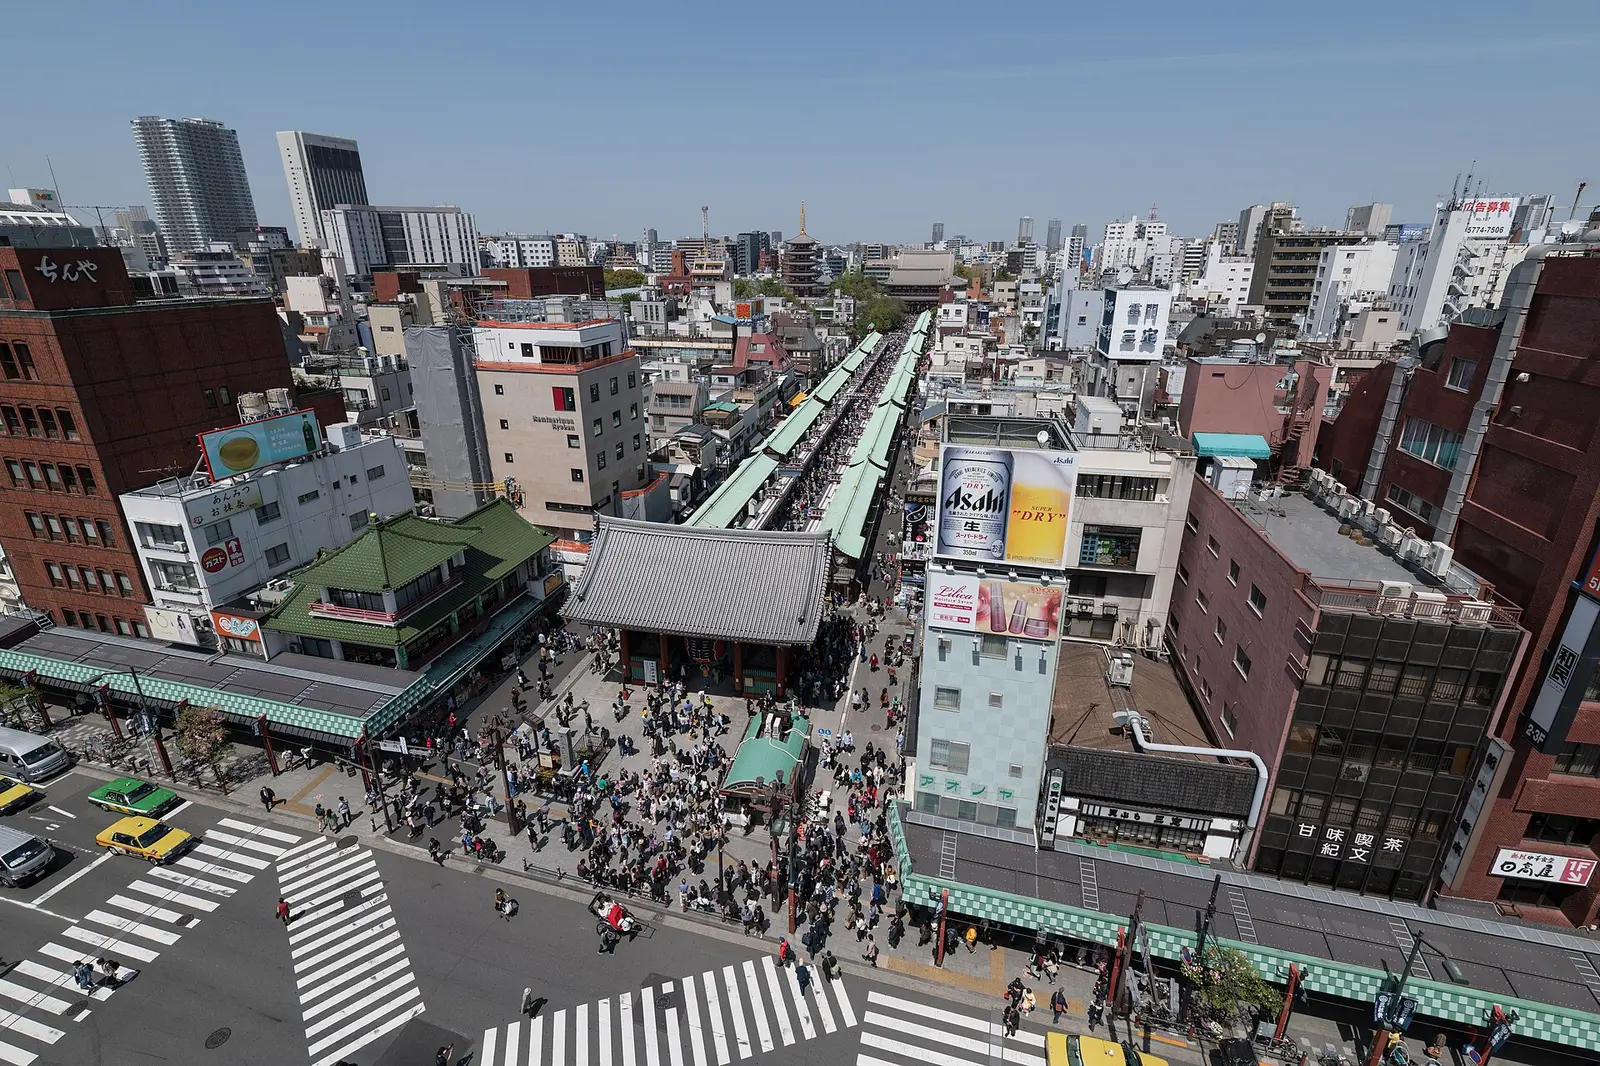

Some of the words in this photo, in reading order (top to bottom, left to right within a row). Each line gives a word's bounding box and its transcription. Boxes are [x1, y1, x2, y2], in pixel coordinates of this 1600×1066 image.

[1464, 201, 1511, 213] 広告募集
[34, 255, 98, 283] ちんや
[1127, 303, 1159, 323] 雷門
[1053, 456, 1073, 465] Asahi
[213, 486, 250, 505] あんみつ
[945, 485, 1005, 514] Asahi
[211, 499, 245, 517] お抹茶
[964, 521, 980, 532] 生
[956, 533, 988, 541] スーパードライ
[205, 555, 226, 568] ガスト
[1552, 648, 1577, 687] 和民
[921, 775, 1012, 801] アオノヤ
[1299, 823, 1404, 852] 甘味喫茶
[1500, 860, 1554, 878] 日高屋
[1569, 861, 1591, 872] 1F
